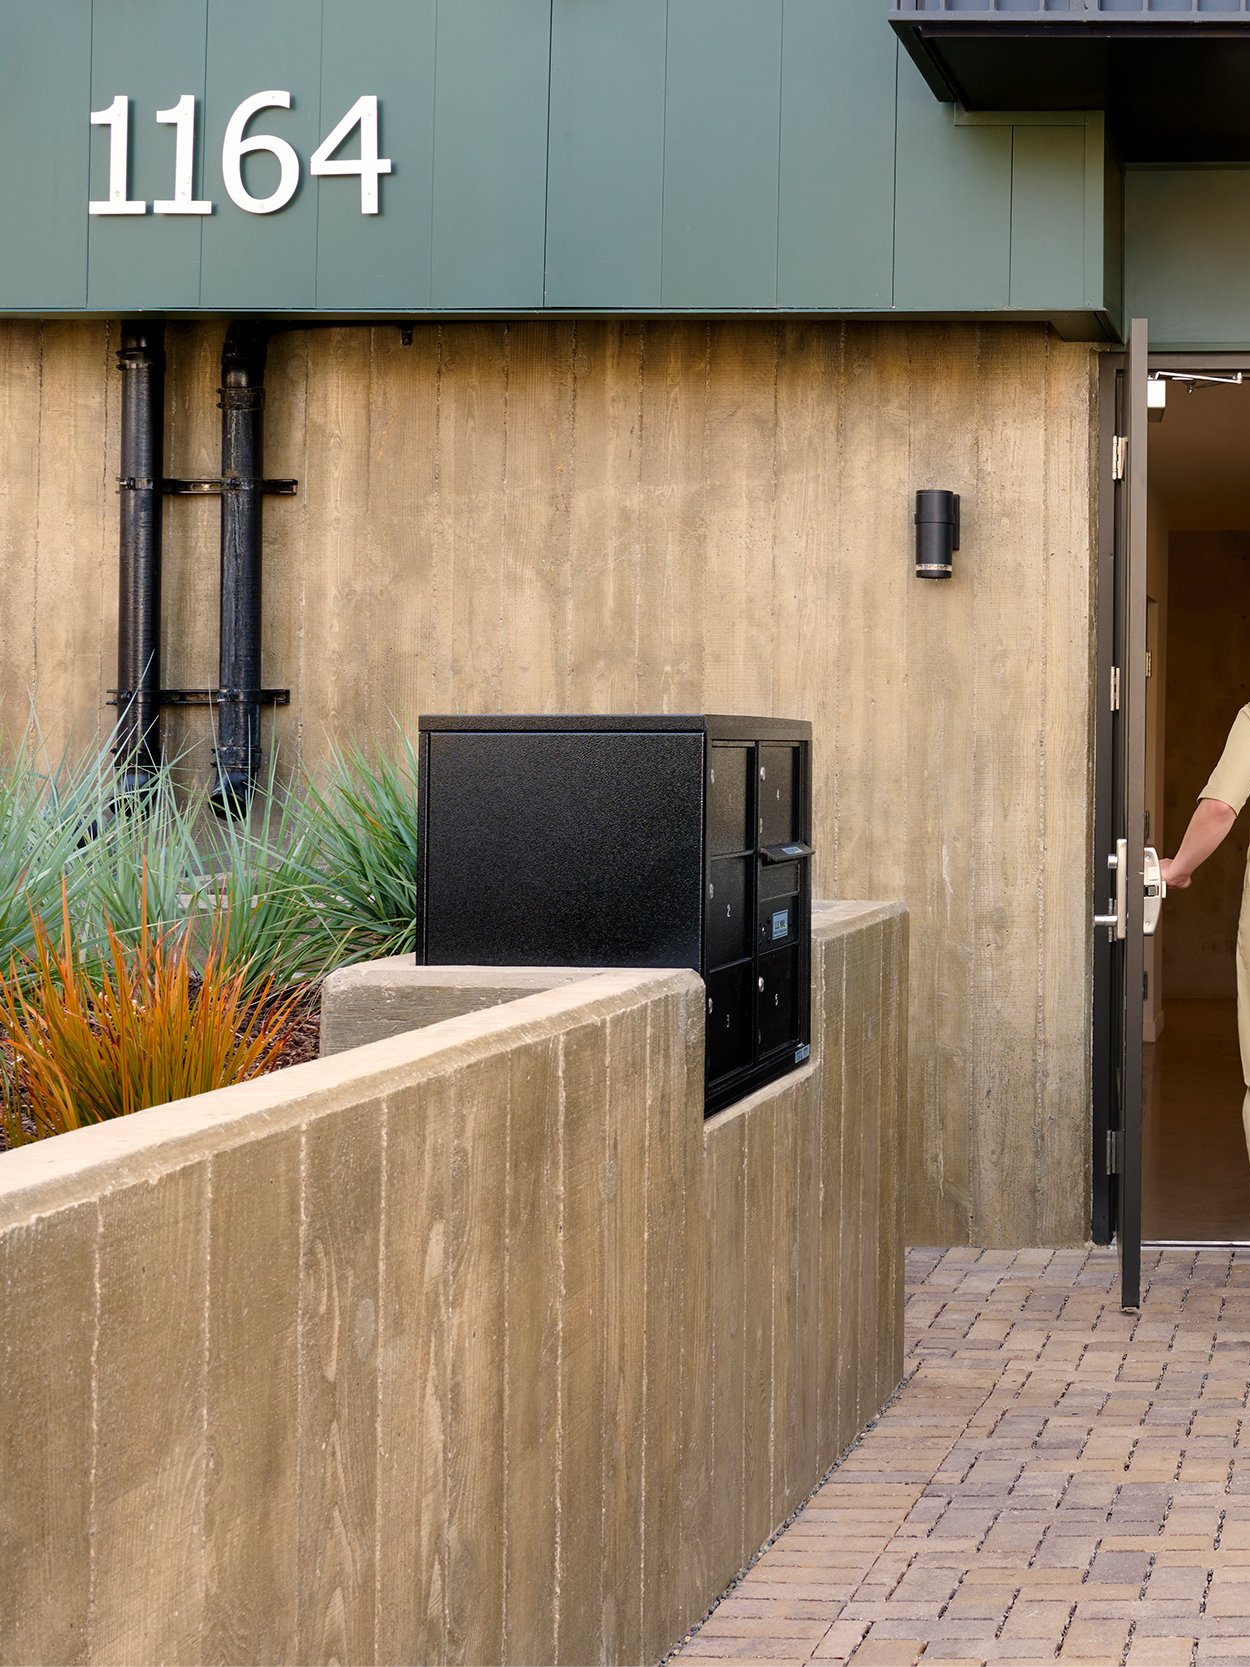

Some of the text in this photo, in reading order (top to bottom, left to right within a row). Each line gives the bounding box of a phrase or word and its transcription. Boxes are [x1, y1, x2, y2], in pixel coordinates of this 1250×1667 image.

[89, 90, 391, 214] 1164
[776, 789, 780, 801] 4
[726, 904, 731, 918] 2
[774, 993, 779, 1006] 5
[726, 1014, 730, 1028] 3
